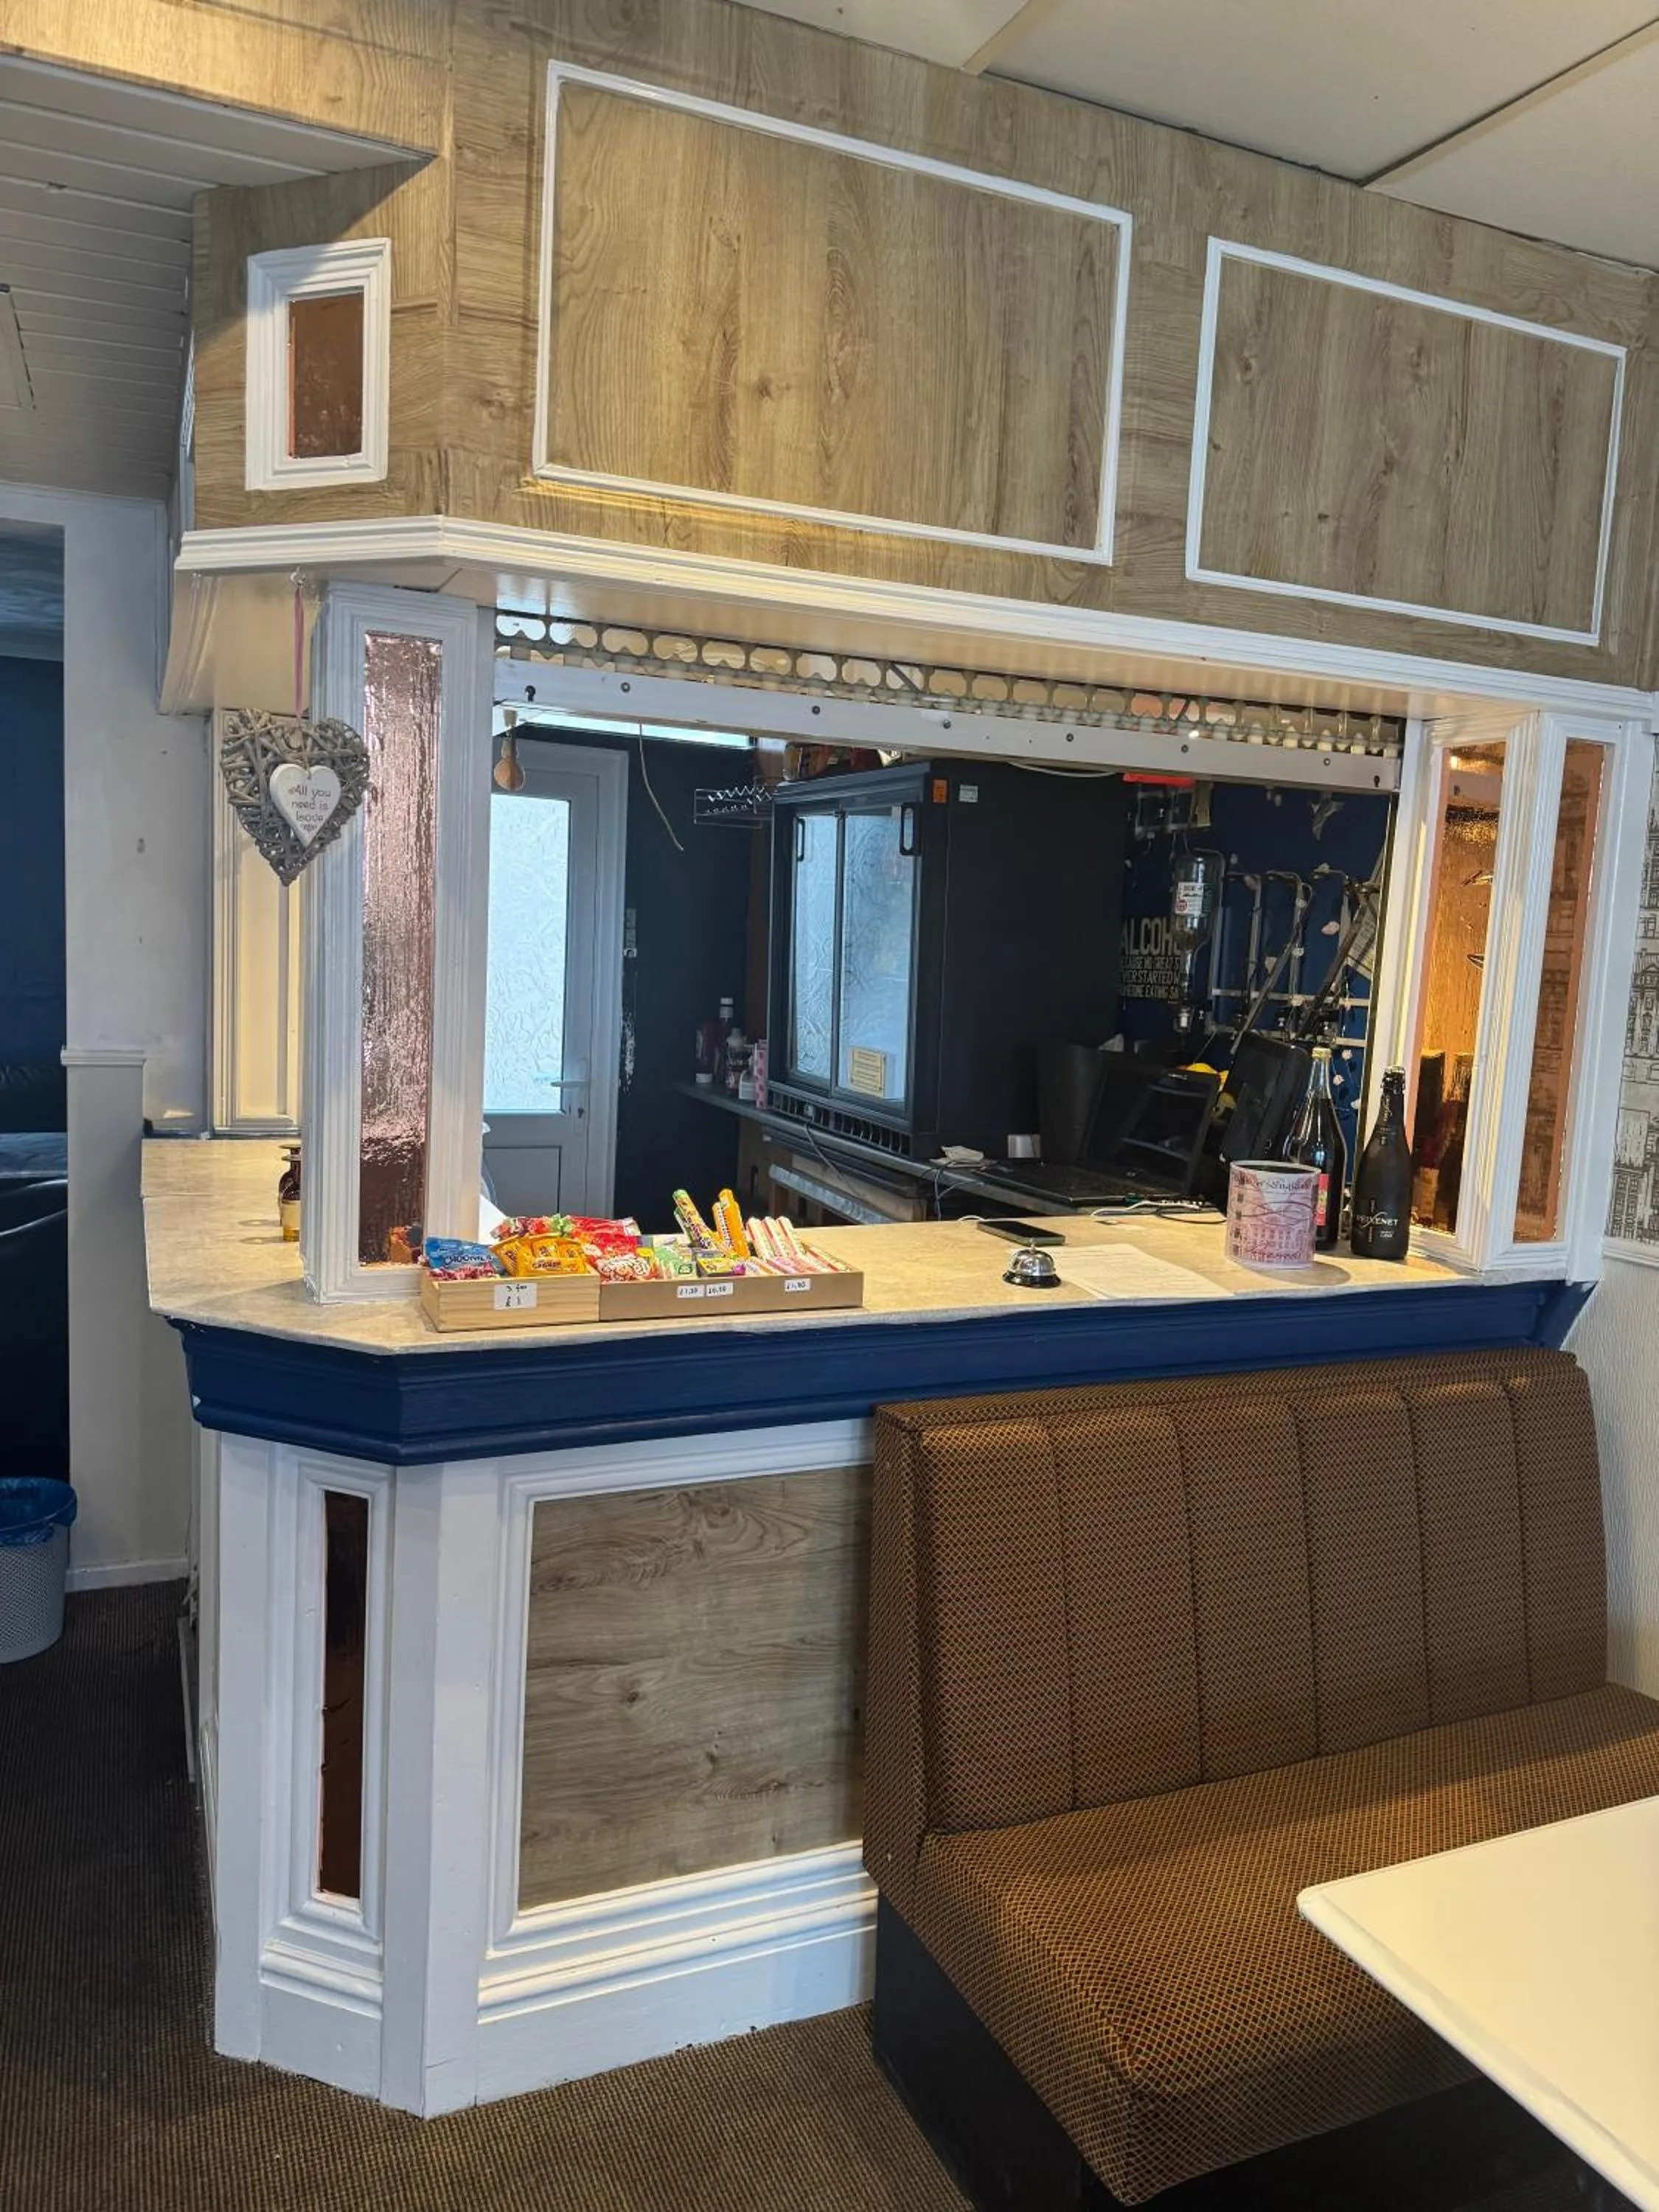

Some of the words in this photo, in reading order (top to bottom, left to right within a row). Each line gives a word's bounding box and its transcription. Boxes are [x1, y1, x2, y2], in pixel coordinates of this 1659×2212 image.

[292, 784, 307, 796] All
[312, 788, 331, 801] you
[292, 801, 316, 810] need
[1120, 917, 1181, 956] ALCOH
